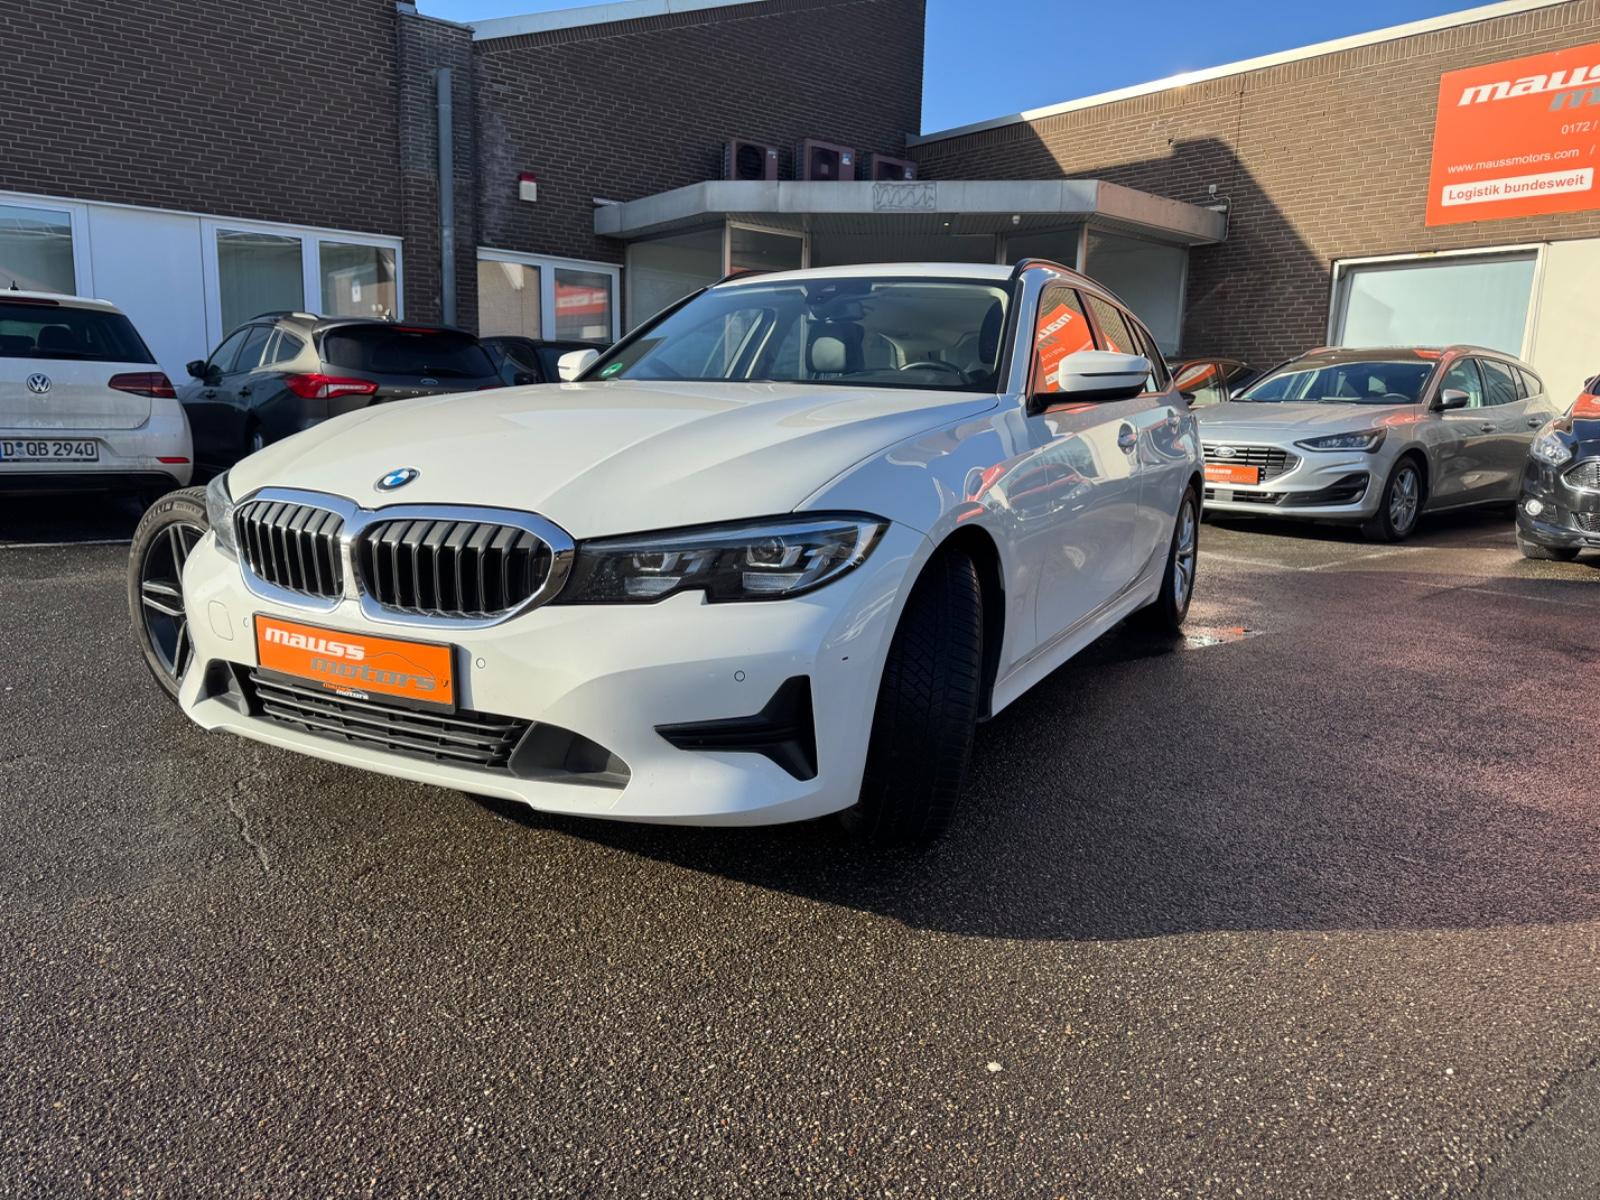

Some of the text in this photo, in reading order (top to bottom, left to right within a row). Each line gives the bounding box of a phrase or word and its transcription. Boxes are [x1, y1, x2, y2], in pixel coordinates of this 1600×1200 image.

[1561, 121, 1590, 135] 0172
[1448, 148, 1579, 174] www.maussmotors.com
[1448, 174, 1585, 201] Logistik bundesweit
[2, 442, 95, 456] D QB 2940
[264, 626, 365, 661] mauss
[311, 657, 436, 691] motors
